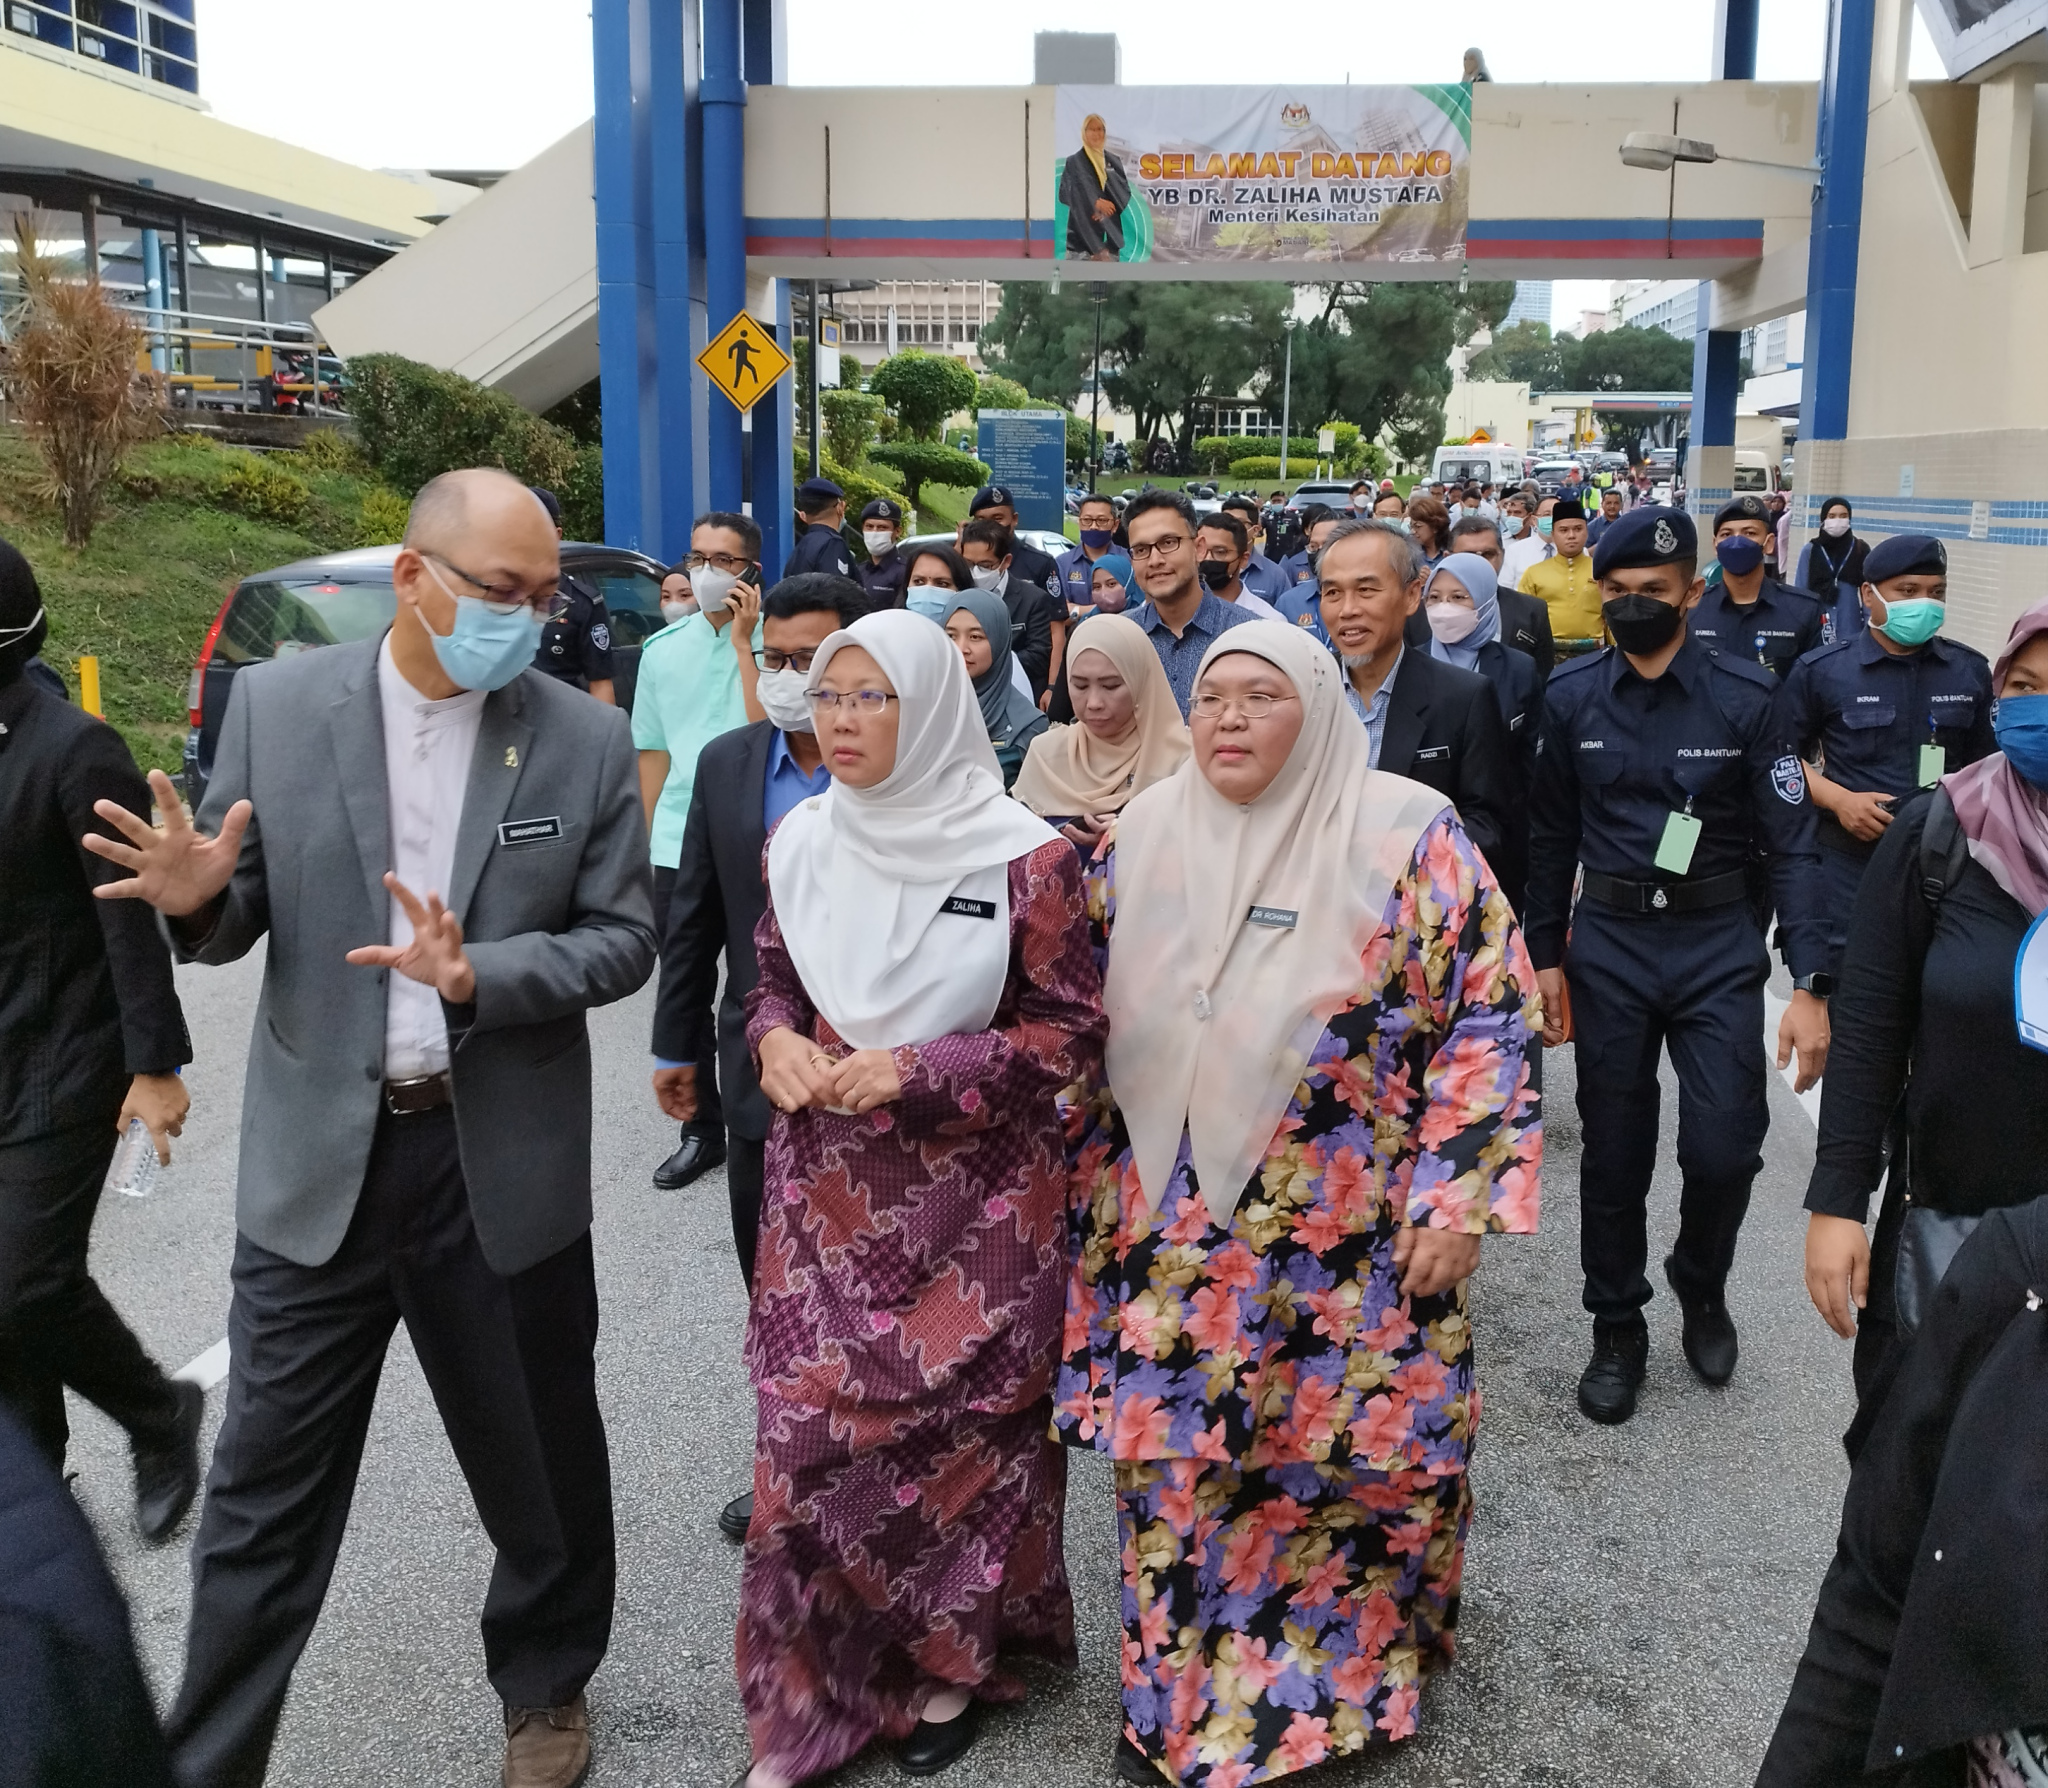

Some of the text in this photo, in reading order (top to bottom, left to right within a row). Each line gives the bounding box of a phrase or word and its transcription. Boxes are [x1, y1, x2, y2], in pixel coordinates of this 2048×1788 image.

[1138, 148, 1452, 180] SELAMAT DATANG
[1148, 184, 1442, 206] YB DR. ZALIHA MUSTAFA
[1208, 207, 1379, 224] Menteri Kesihatan
[1580, 740, 1603, 749] AKBAR
[1677, 749, 1742, 757] POLIS BANTUAN
[952, 900, 981, 914] ZALIHA
